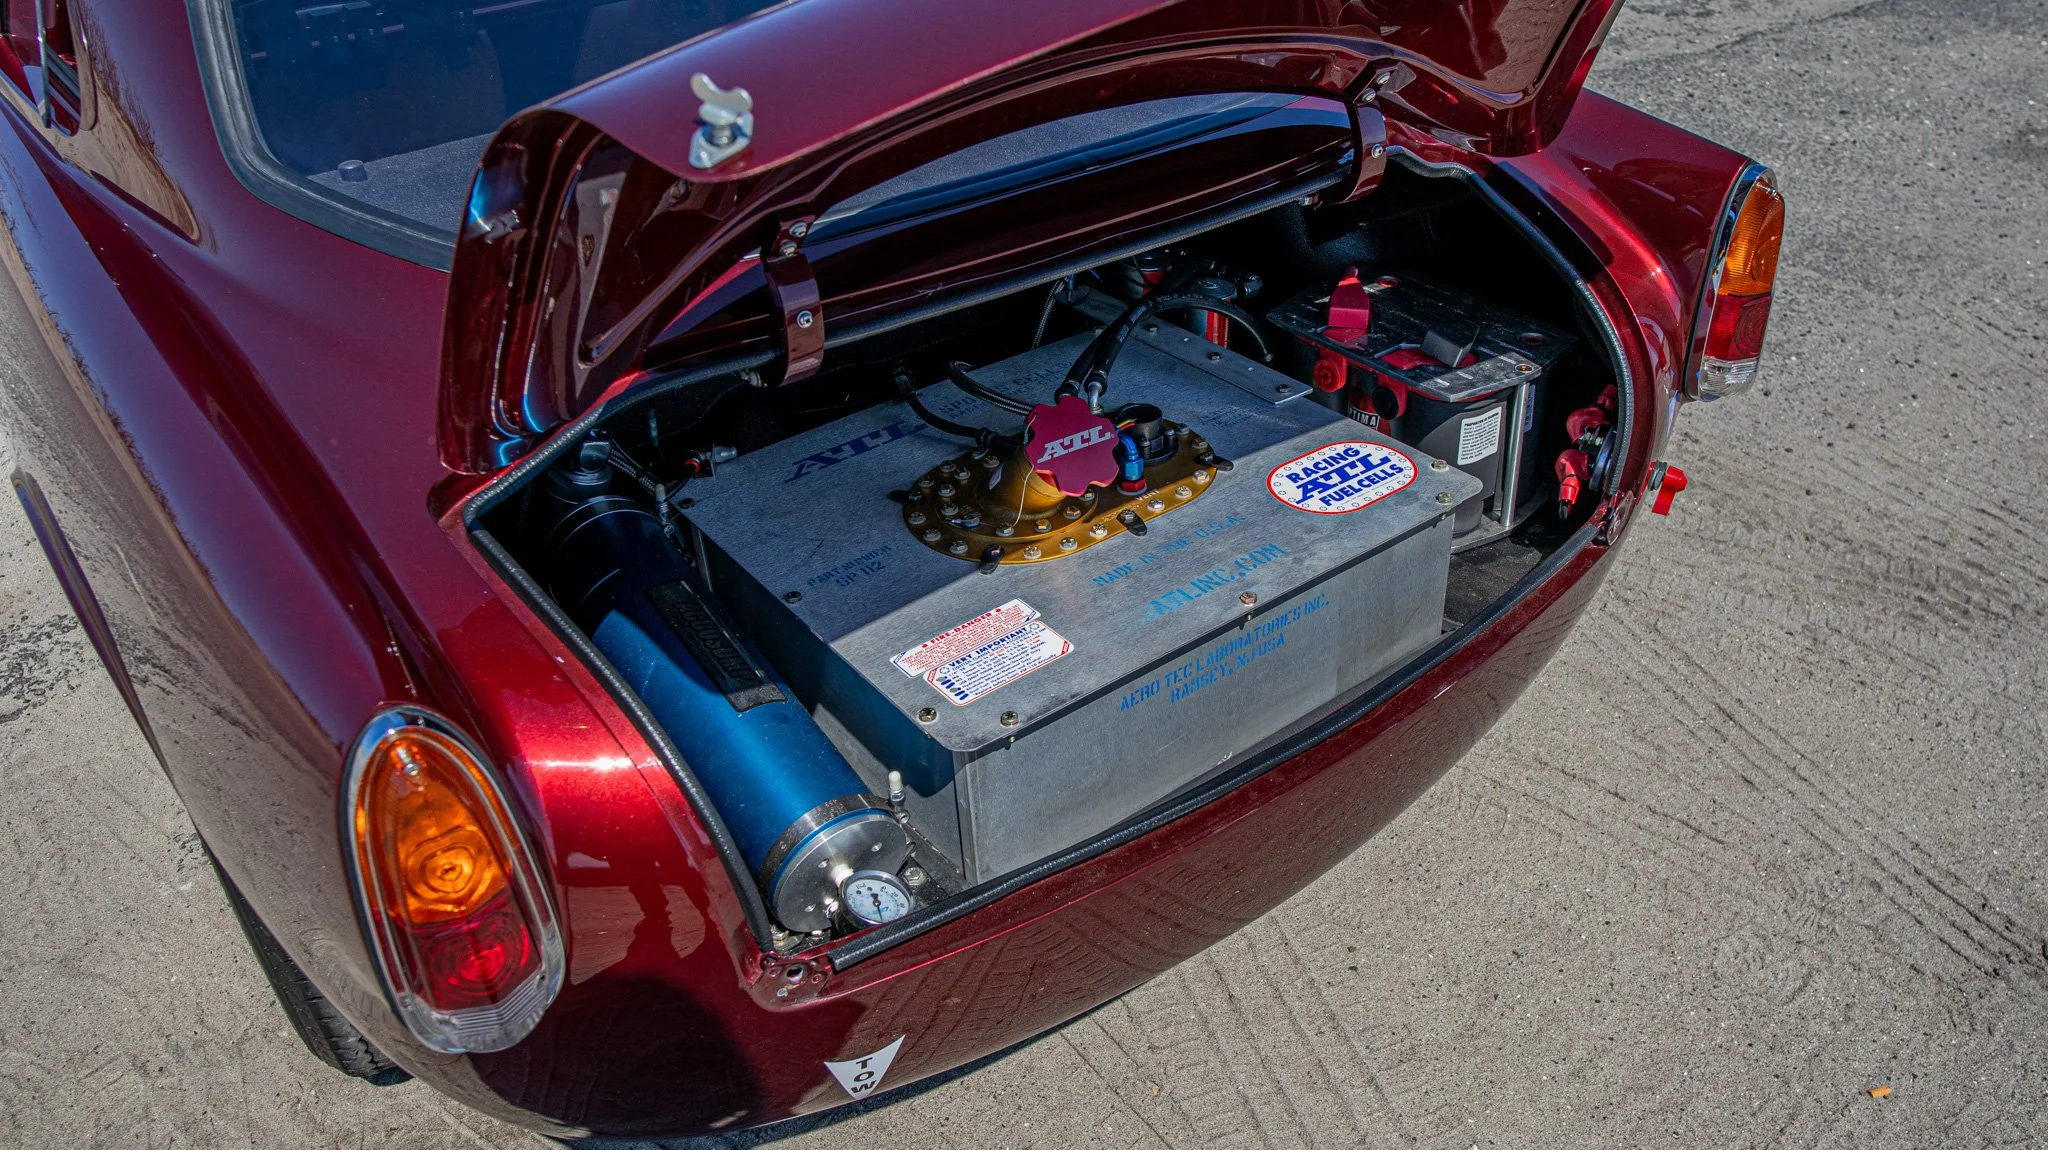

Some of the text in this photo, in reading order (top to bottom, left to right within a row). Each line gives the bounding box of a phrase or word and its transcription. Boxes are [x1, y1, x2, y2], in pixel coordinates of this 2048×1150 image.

[784, 420, 929, 483] ATL
[1037, 425, 1111, 464] ATL
[1285, 447, 1361, 484] RACING
[1295, 453, 1392, 505] ATL
[1318, 484, 1363, 507] FUEL
[1357, 463, 1405, 489] CELLS
[1136, 489, 1160, 501] VENT
[807, 545, 892, 587] PART NUMBER
[835, 561, 886, 587] SP 112
[1092, 562, 1140, 587] MADE
[1139, 552, 1160, 566] IN
[1146, 543, 1288, 616] ATLINC.COM
[948, 653, 973, 667] VERY
[975, 626, 1028, 654] IMPORTANT
[1120, 593, 1331, 713] AERO TEC LABORATORIES INC.
[1170, 632, 1285, 705] RAMSEY, NJ USA
[851, 1057, 877, 1093] TOW
